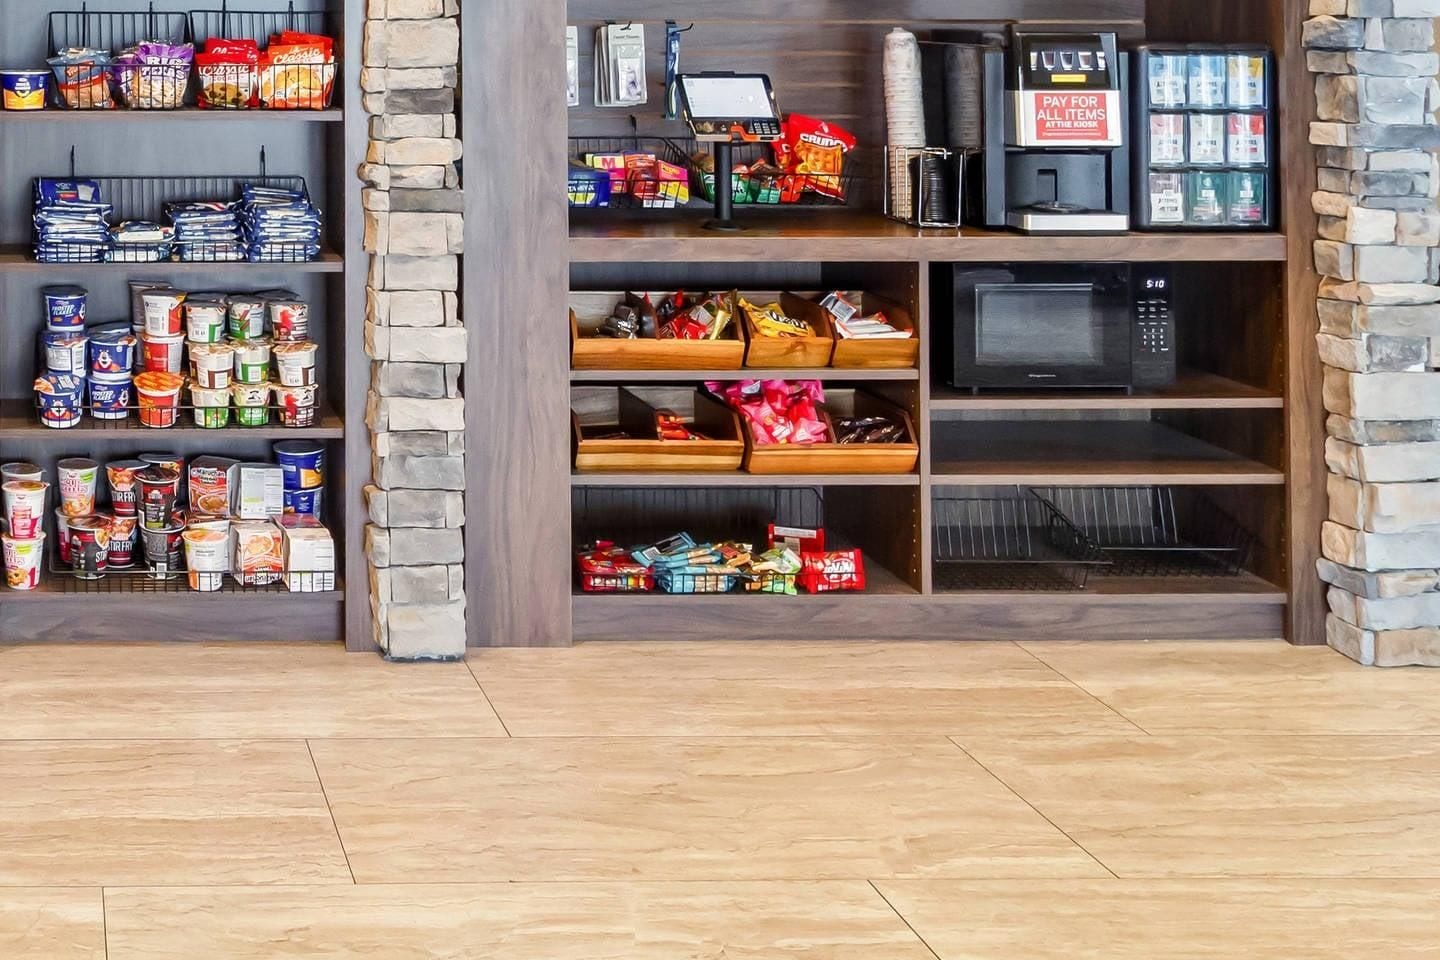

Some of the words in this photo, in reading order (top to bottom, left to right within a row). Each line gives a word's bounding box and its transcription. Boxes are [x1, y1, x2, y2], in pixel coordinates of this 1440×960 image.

[1043, 96, 1068, 108] PAY
[1071, 96, 1098, 108] FOR
[1037, 109, 1062, 121] ALL
[1065, 109, 1106, 121] ITEMS
